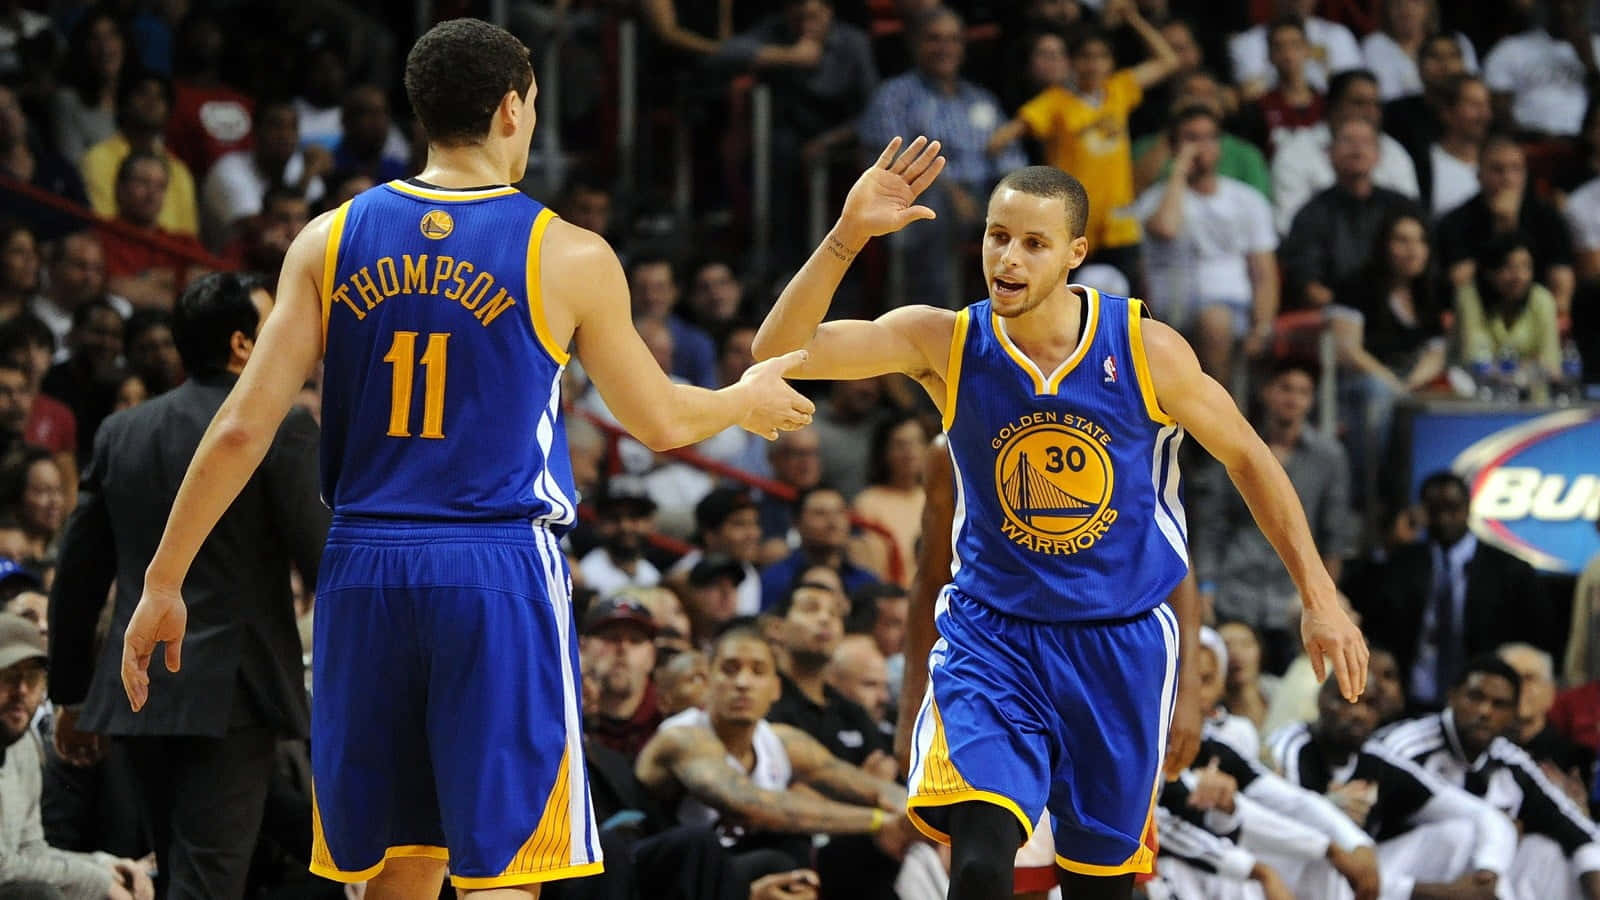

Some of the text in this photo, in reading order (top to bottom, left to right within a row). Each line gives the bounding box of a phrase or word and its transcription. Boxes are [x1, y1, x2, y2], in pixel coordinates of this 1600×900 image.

[331, 254, 516, 327] THOMPSON
[383, 331, 451, 439] 11
[991, 411, 1112, 450] GOLDEN STATE
[1045, 445, 1086, 474] 30
[1000, 507, 1119, 556] WARRIORS
